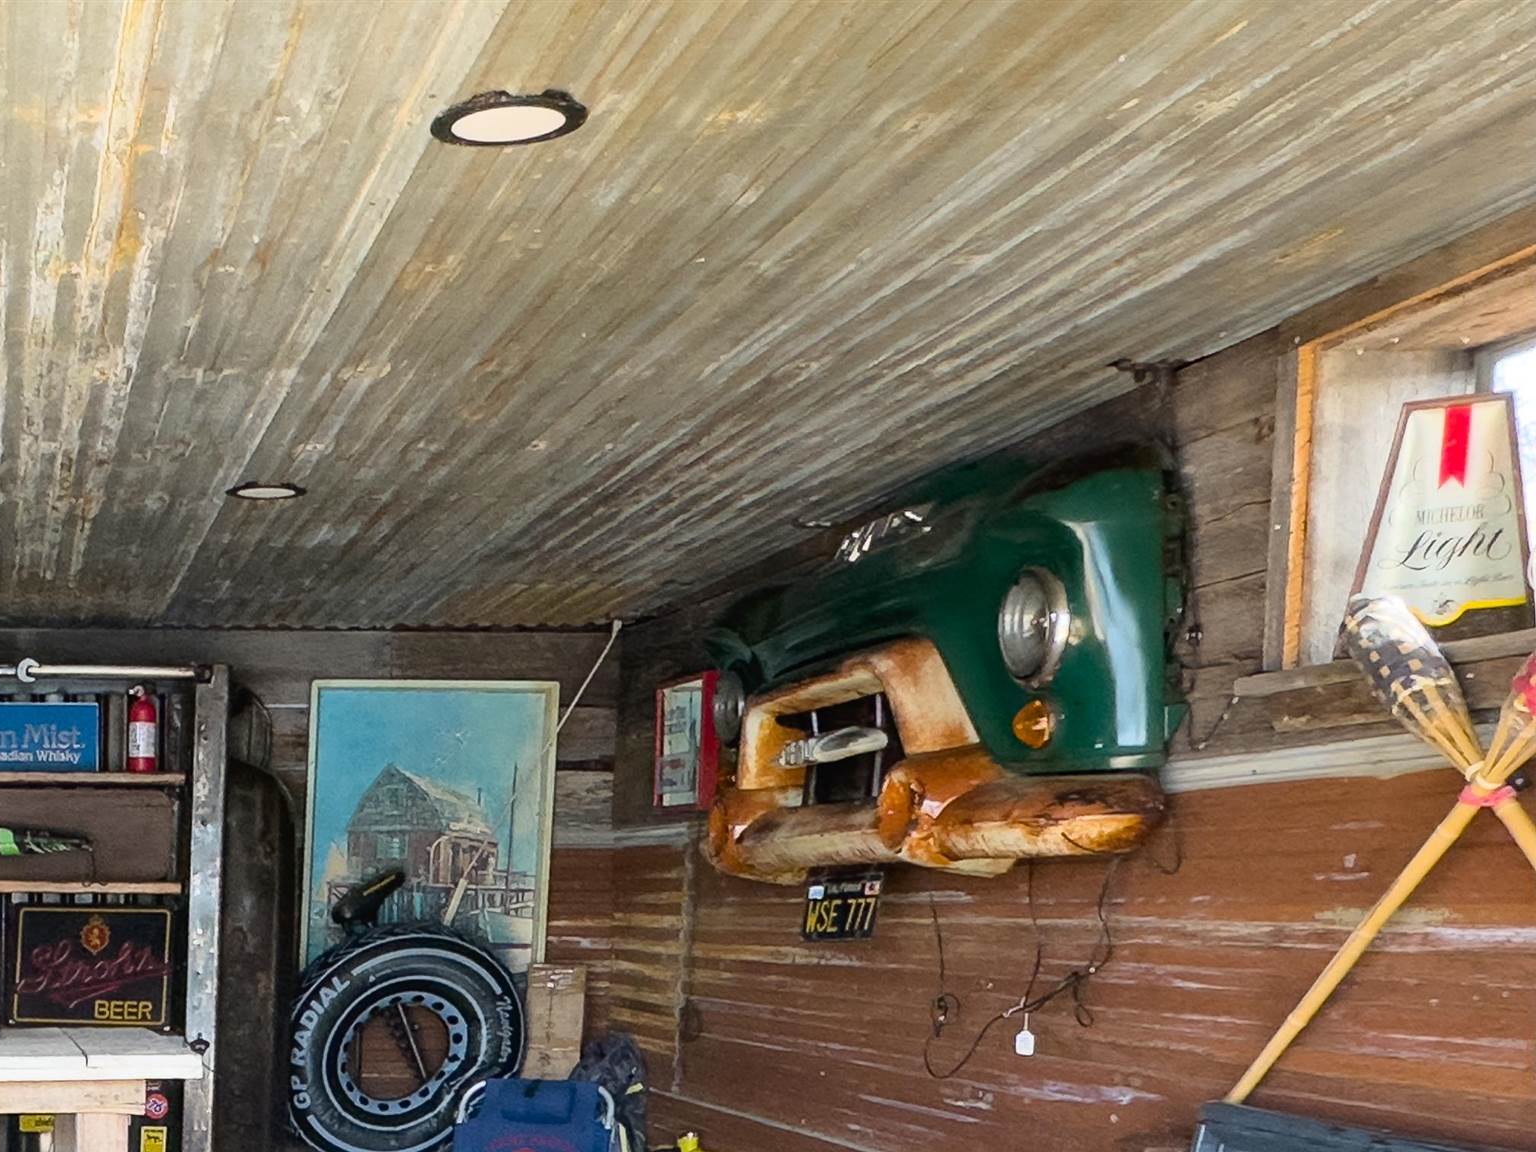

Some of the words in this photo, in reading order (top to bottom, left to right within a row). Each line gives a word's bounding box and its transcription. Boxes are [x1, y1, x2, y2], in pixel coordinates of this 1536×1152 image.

[1416, 503, 1486, 526] MICHELOB
[1378, 522, 1512, 570] Light
[36, 749, 81, 764] Whisky
[806, 900, 842, 933] WSE
[845, 897, 876, 931] 777
[94, 1000, 153, 1020] BEER
[290, 976, 351, 1067] RADIAL
[291, 1075, 311, 1110] GP
